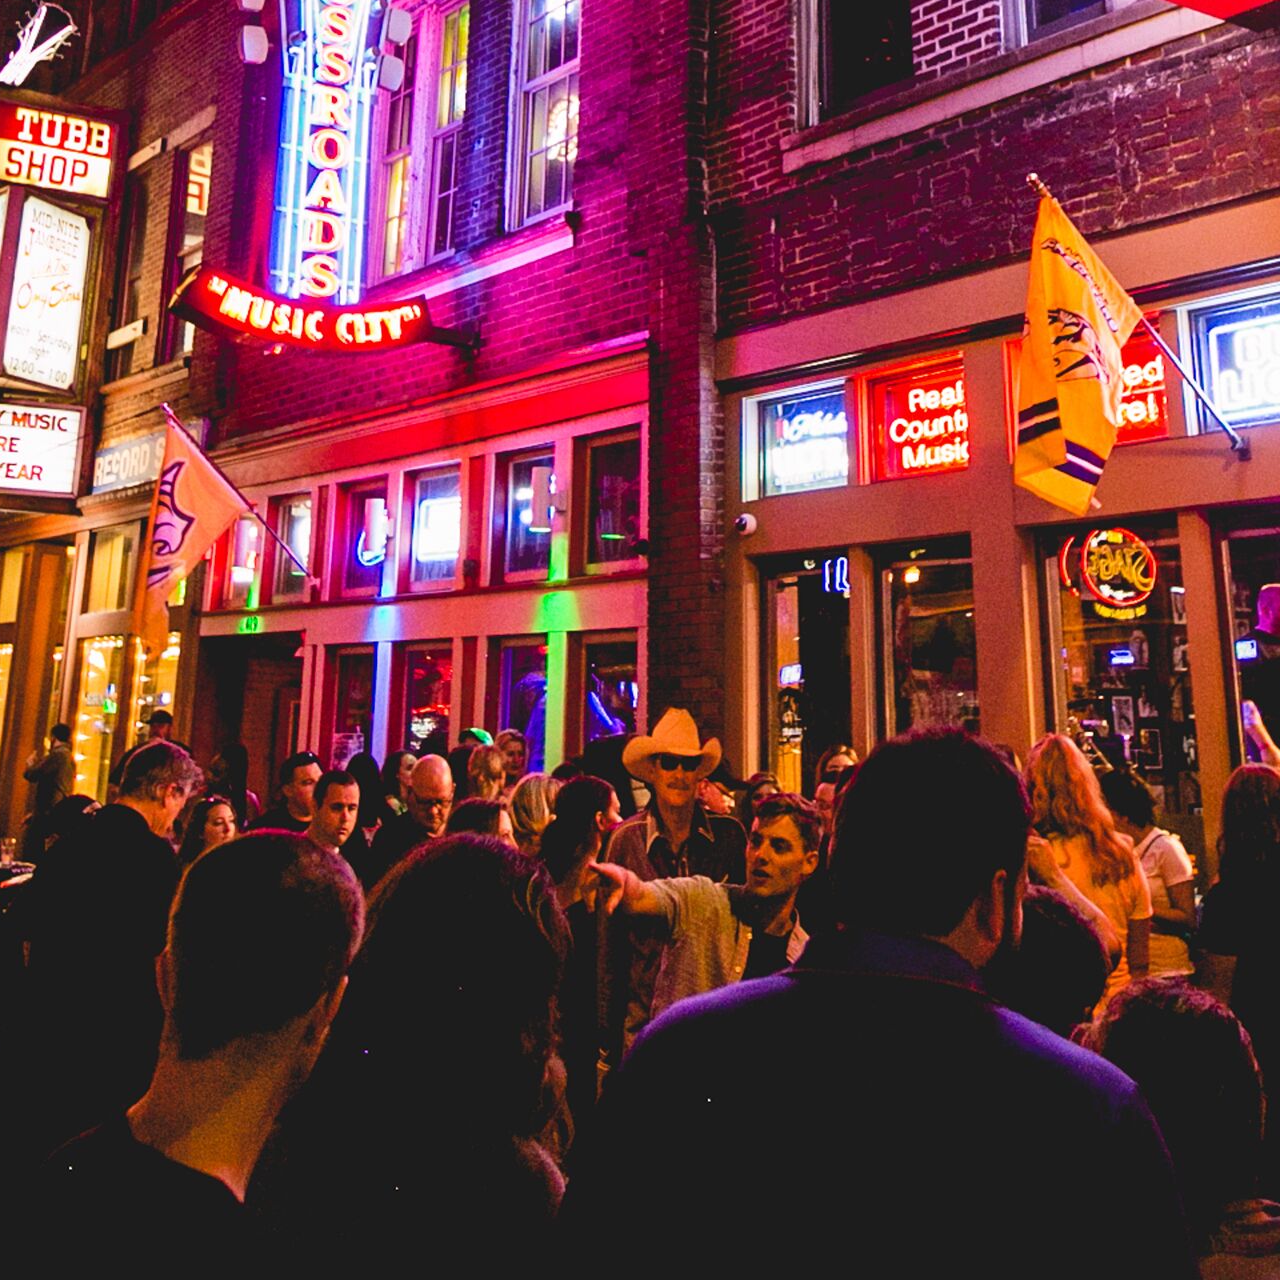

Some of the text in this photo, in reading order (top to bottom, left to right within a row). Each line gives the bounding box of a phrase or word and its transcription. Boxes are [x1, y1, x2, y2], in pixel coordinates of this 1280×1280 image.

[16, 108, 111, 157] TUBB
[4, 146, 89, 188] SHOP
[31, 207, 81, 241] MID-NITE
[907, 379, 965, 414] Real
[11, 410, 69, 433] MUSIC
[93, 443, 151, 487] RECORD
